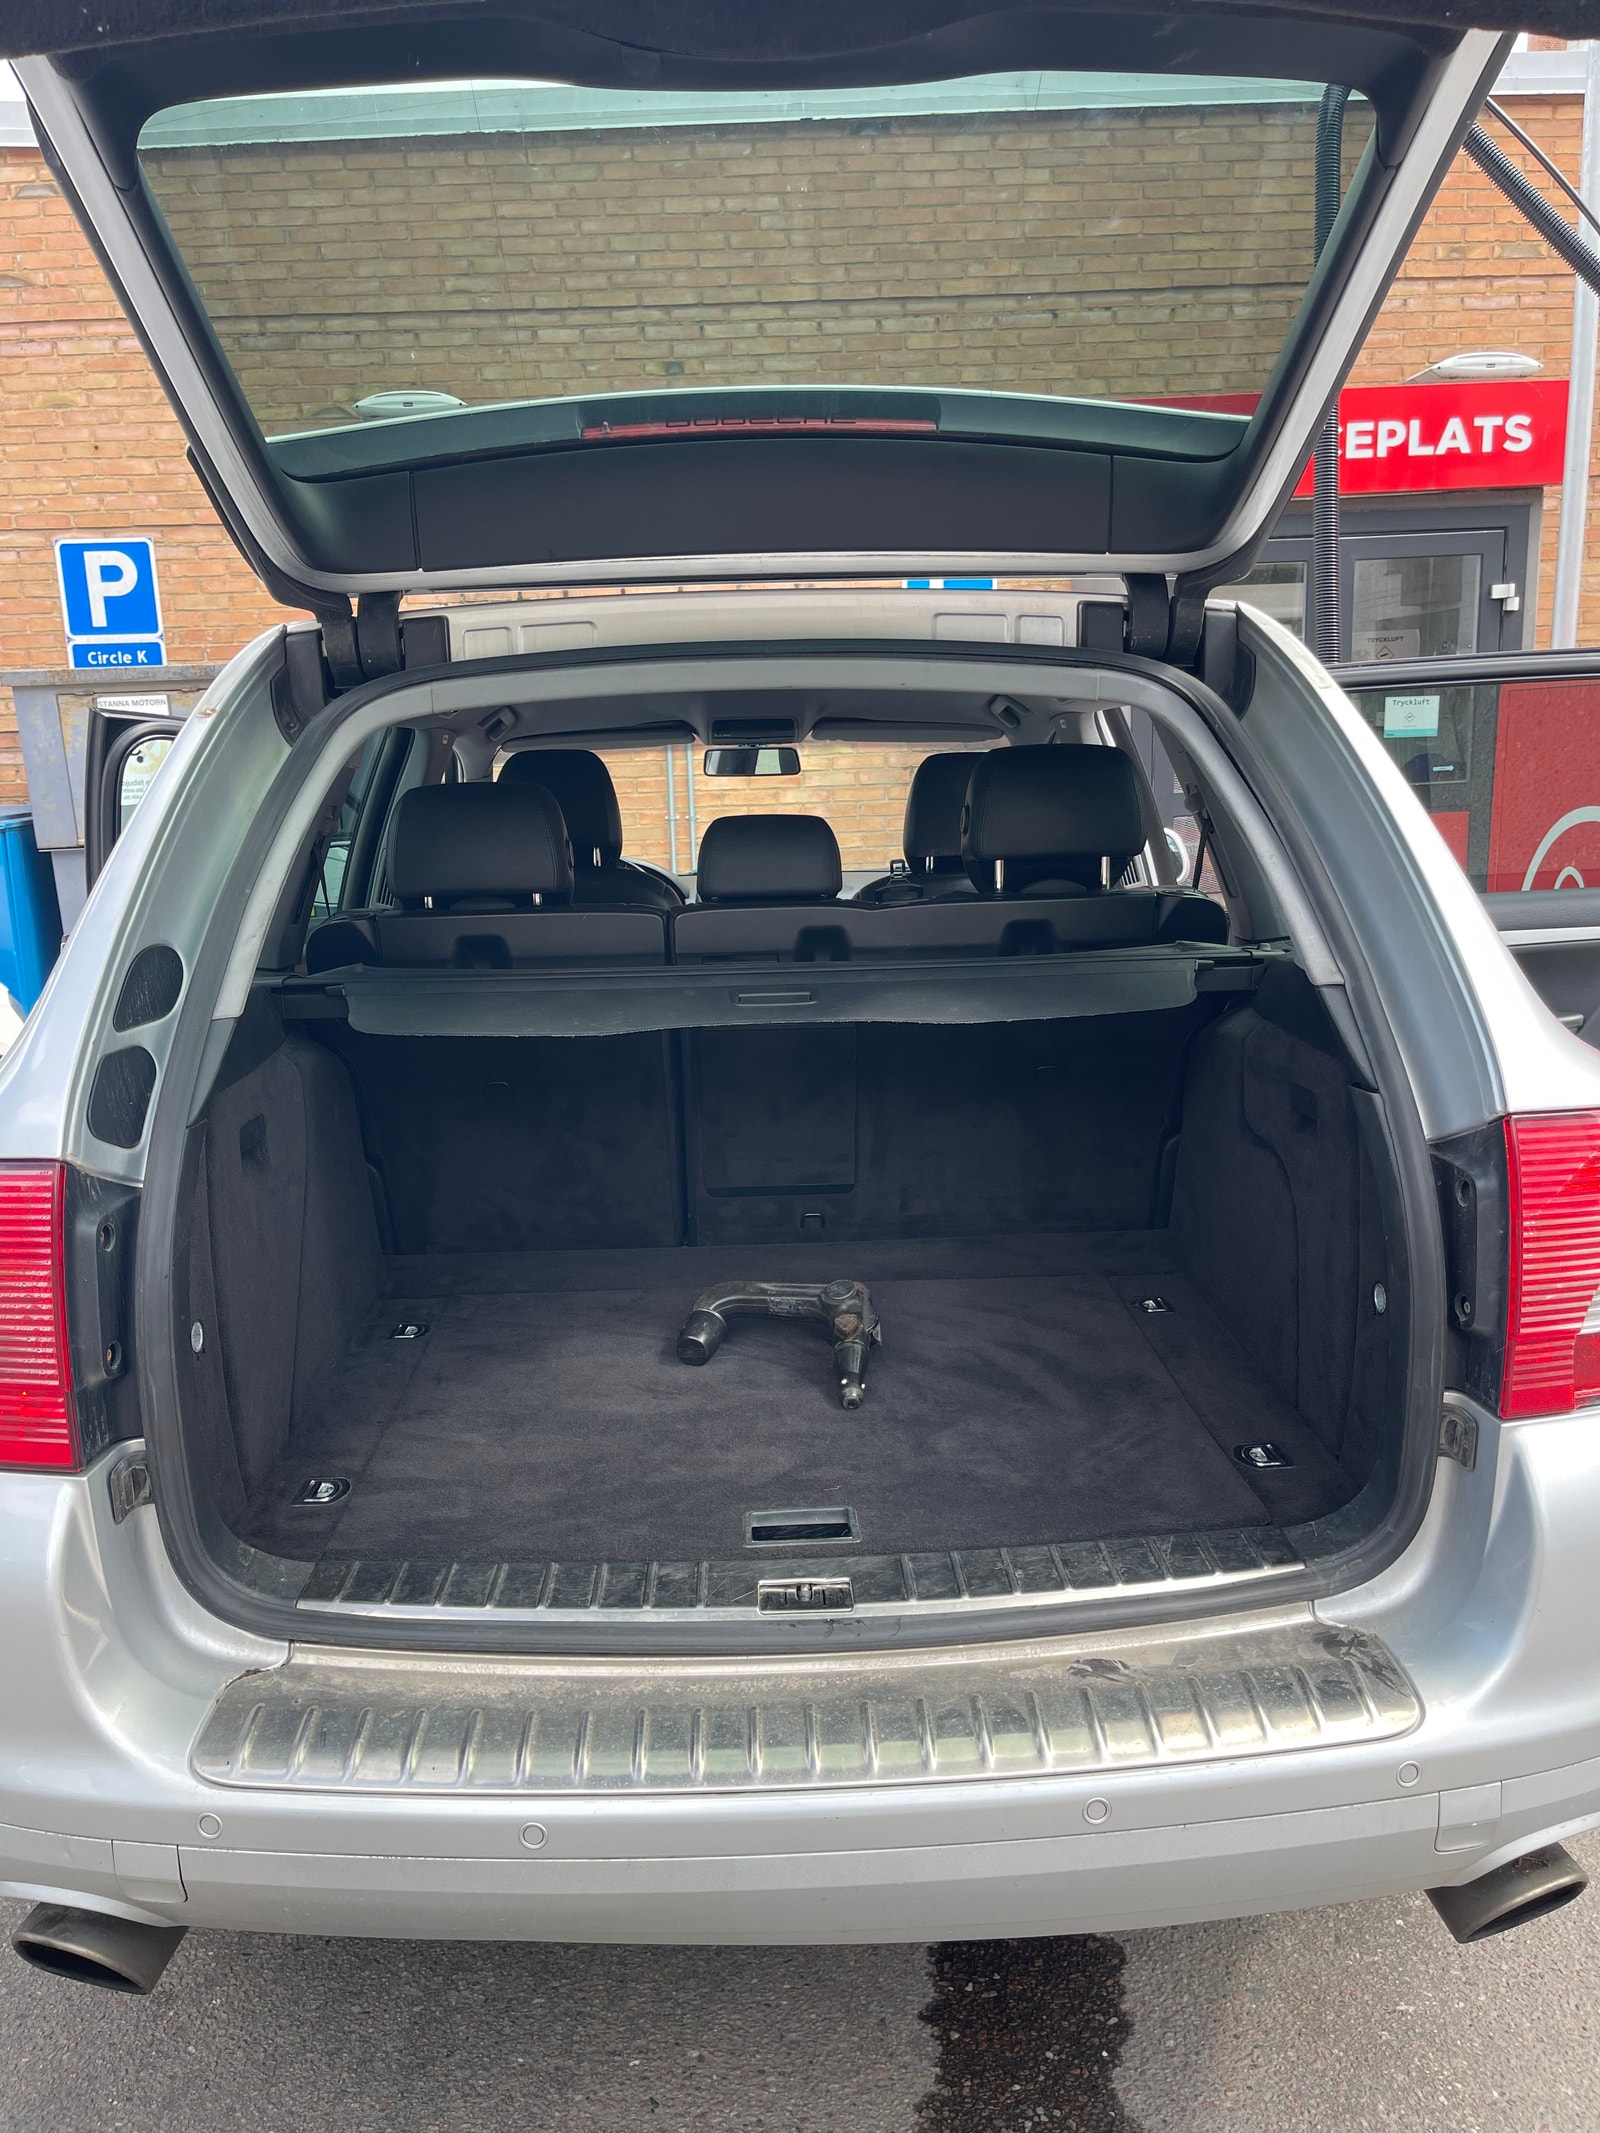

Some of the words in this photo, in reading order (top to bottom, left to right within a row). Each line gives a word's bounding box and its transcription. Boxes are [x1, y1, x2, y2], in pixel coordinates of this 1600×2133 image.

[83, 550, 138, 628] P
[87, 651, 132, 665] Circle
[137, 650, 148, 663] K
[97, 700, 130, 708] STANNA
[131, 698, 167, 707] MOTORN
[1393, 699, 1430, 707] Tryckluft
